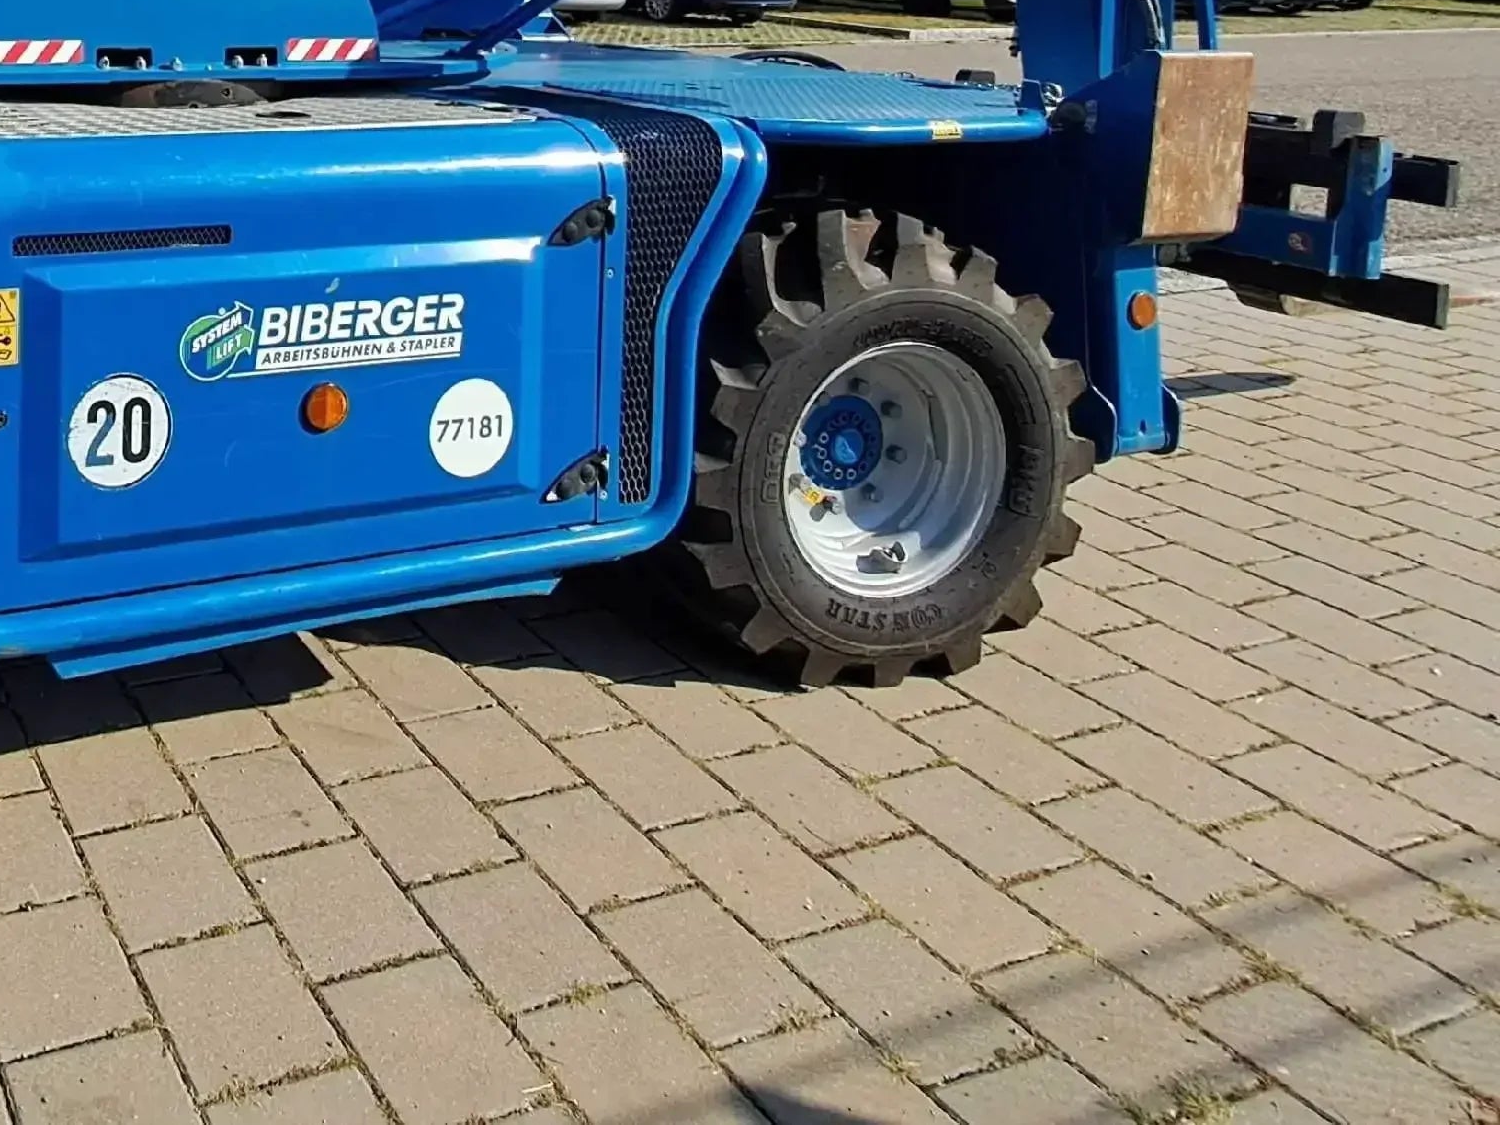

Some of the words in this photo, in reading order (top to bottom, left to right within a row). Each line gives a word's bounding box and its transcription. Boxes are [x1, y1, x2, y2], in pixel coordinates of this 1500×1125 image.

[191, 310, 243, 353] SYSTEM
[258, 293, 465, 346] BIBERGER
[215, 334, 244, 361] LIFT
[261, 342, 382, 366] ARBEITSBÜHNEN
[386, 341, 397, 355] &
[399, 336, 456, 353] STAPLER
[84, 396, 153, 468] 20
[436, 413, 504, 444] 77181
